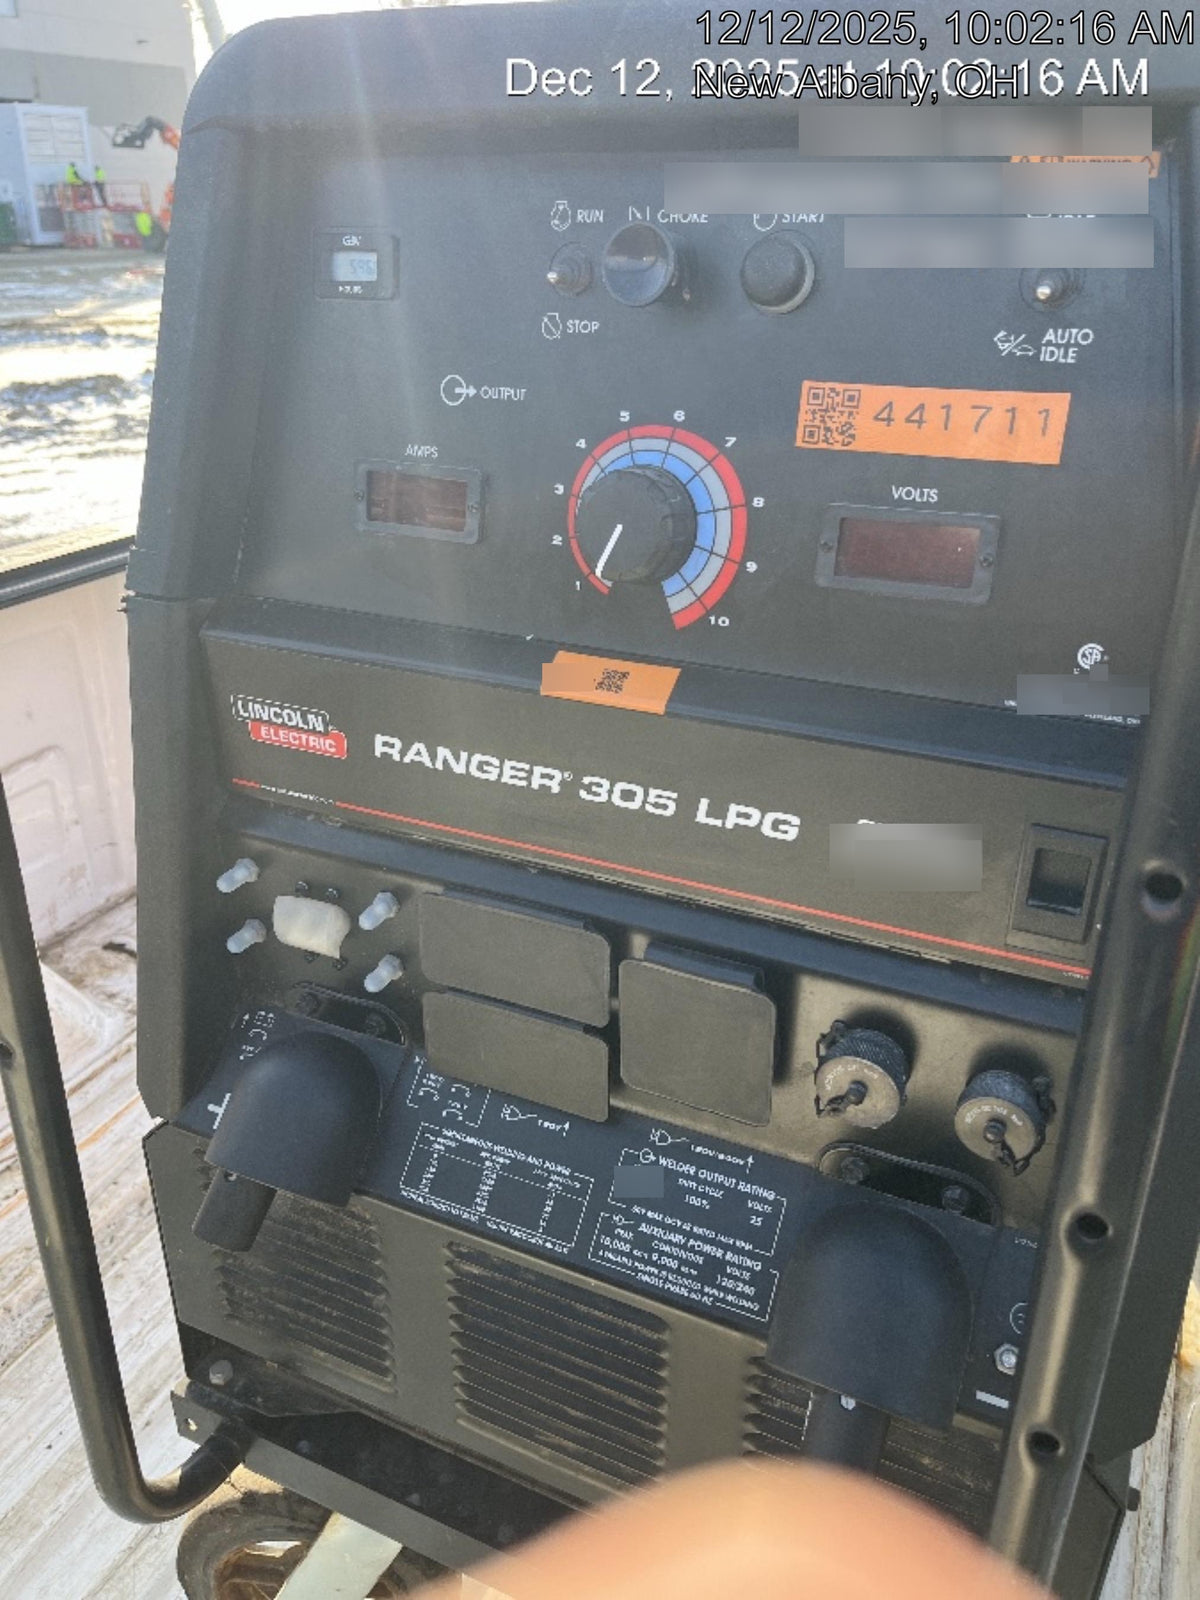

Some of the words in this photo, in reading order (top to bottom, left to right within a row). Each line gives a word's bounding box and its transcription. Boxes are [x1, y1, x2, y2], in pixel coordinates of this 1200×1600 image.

[577, 209, 605, 224] RUN
[566, 320, 600, 334] STOP
[1042, 328, 1094, 346] AUTO
[1039, 346, 1077, 364] IDLE
[480, 384, 528, 401] OUTPUT
[619, 411, 630, 422] 5
[673, 410, 686, 422] 6
[872, 400, 1053, 438] 441711
[575, 438, 586, 449] 4
[724, 437, 737, 447] 7
[405, 444, 439, 459] AMPS
[554, 484, 564, 494] 3
[892, 485, 938, 503] VOLTS
[752, 497, 765, 508] 8
[551, 536, 563, 545] 2
[745, 561, 758, 573] 9
[575, 580, 581, 590] 1
[708, 616, 730, 627] 10
[237, 700, 325, 732] LINCOLN
[260, 725, 337, 752] ELECTRIC
[579, 775, 678, 817] 305
[695, 797, 801, 842] LPG
[659, 1155, 696, 1176] WELDER
[698, 1169, 736, 1188] OUTPUT
[737, 1181, 776, 1200] RATING
